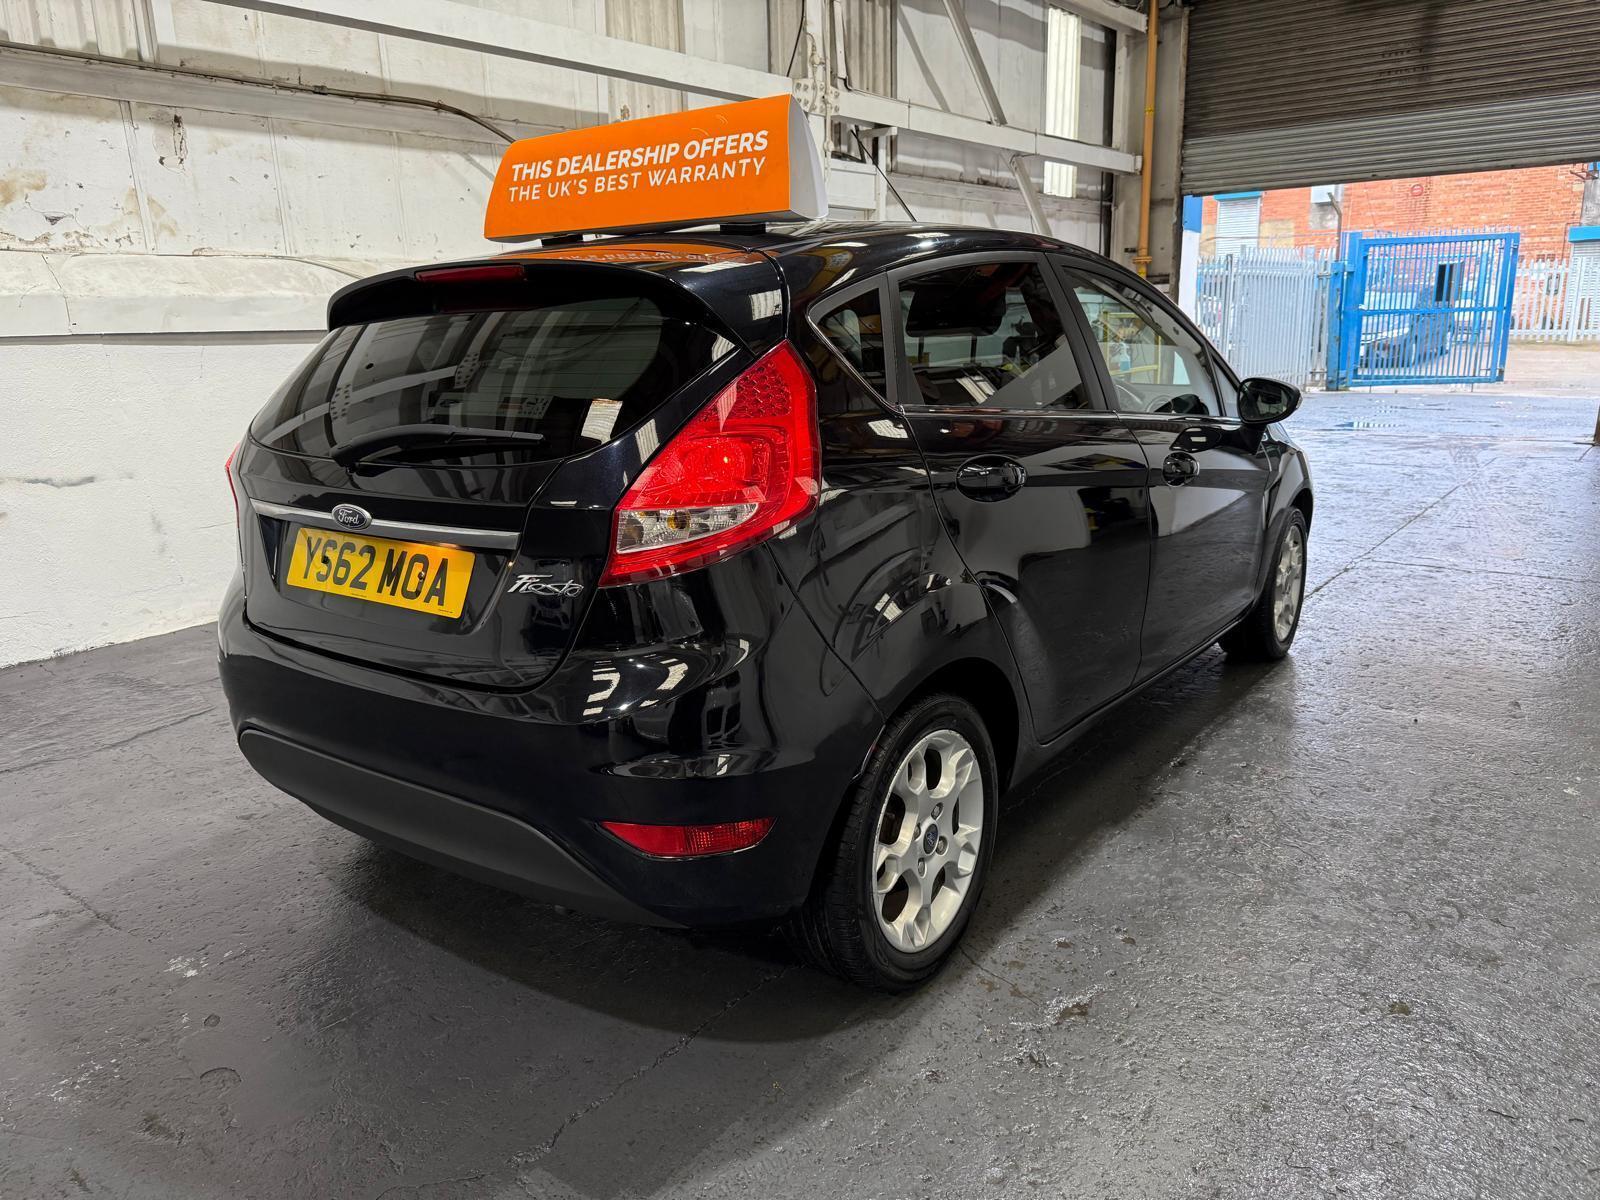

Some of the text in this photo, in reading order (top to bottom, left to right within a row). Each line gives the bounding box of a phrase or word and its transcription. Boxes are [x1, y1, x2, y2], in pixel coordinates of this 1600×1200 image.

[509, 156, 767, 202] THE UK'S BEST WARRANTY
[511, 130, 768, 181] THIS DEALERSHIP OFFERS
[302, 536, 450, 606] YS62 MOA
[507, 574, 584, 598] Fiesta
